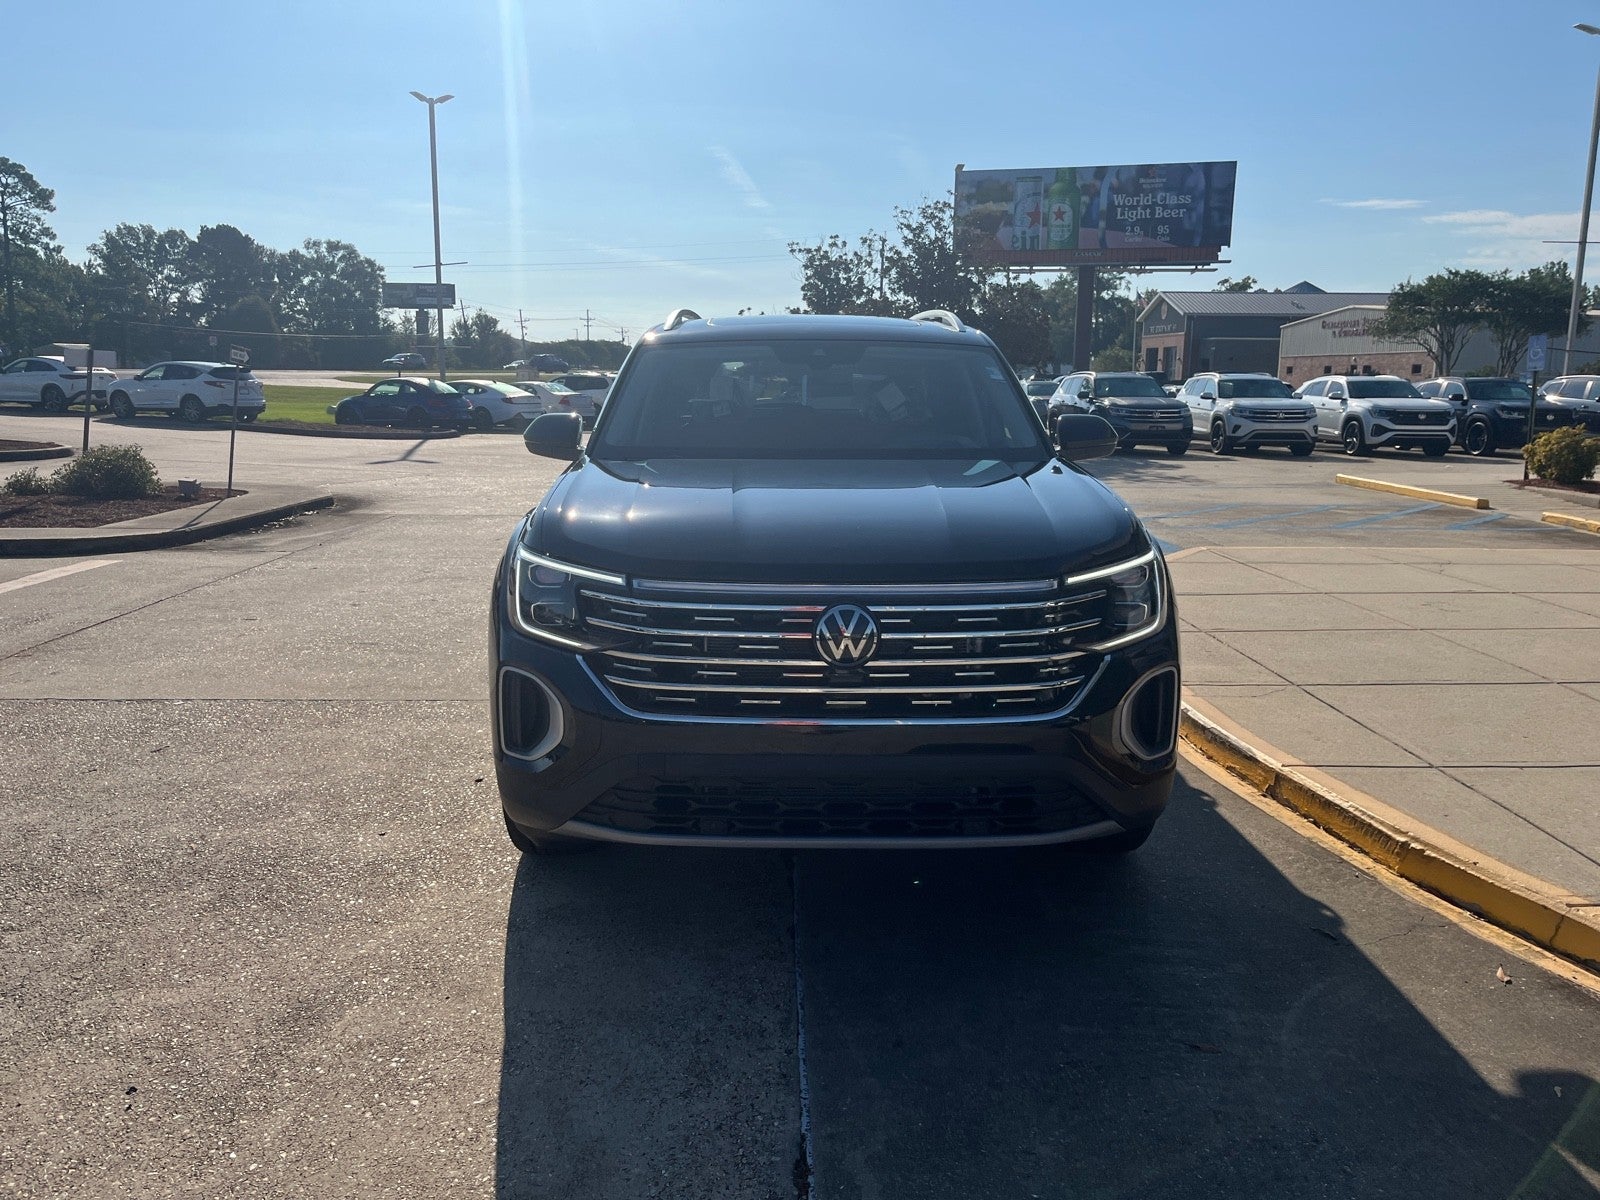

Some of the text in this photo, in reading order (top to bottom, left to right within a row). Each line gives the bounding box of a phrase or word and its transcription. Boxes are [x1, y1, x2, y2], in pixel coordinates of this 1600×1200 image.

[1113, 192, 1193, 207] World-Class
[1116, 207, 1187, 223] Light Beer
[1157, 225, 1170, 235] 95
